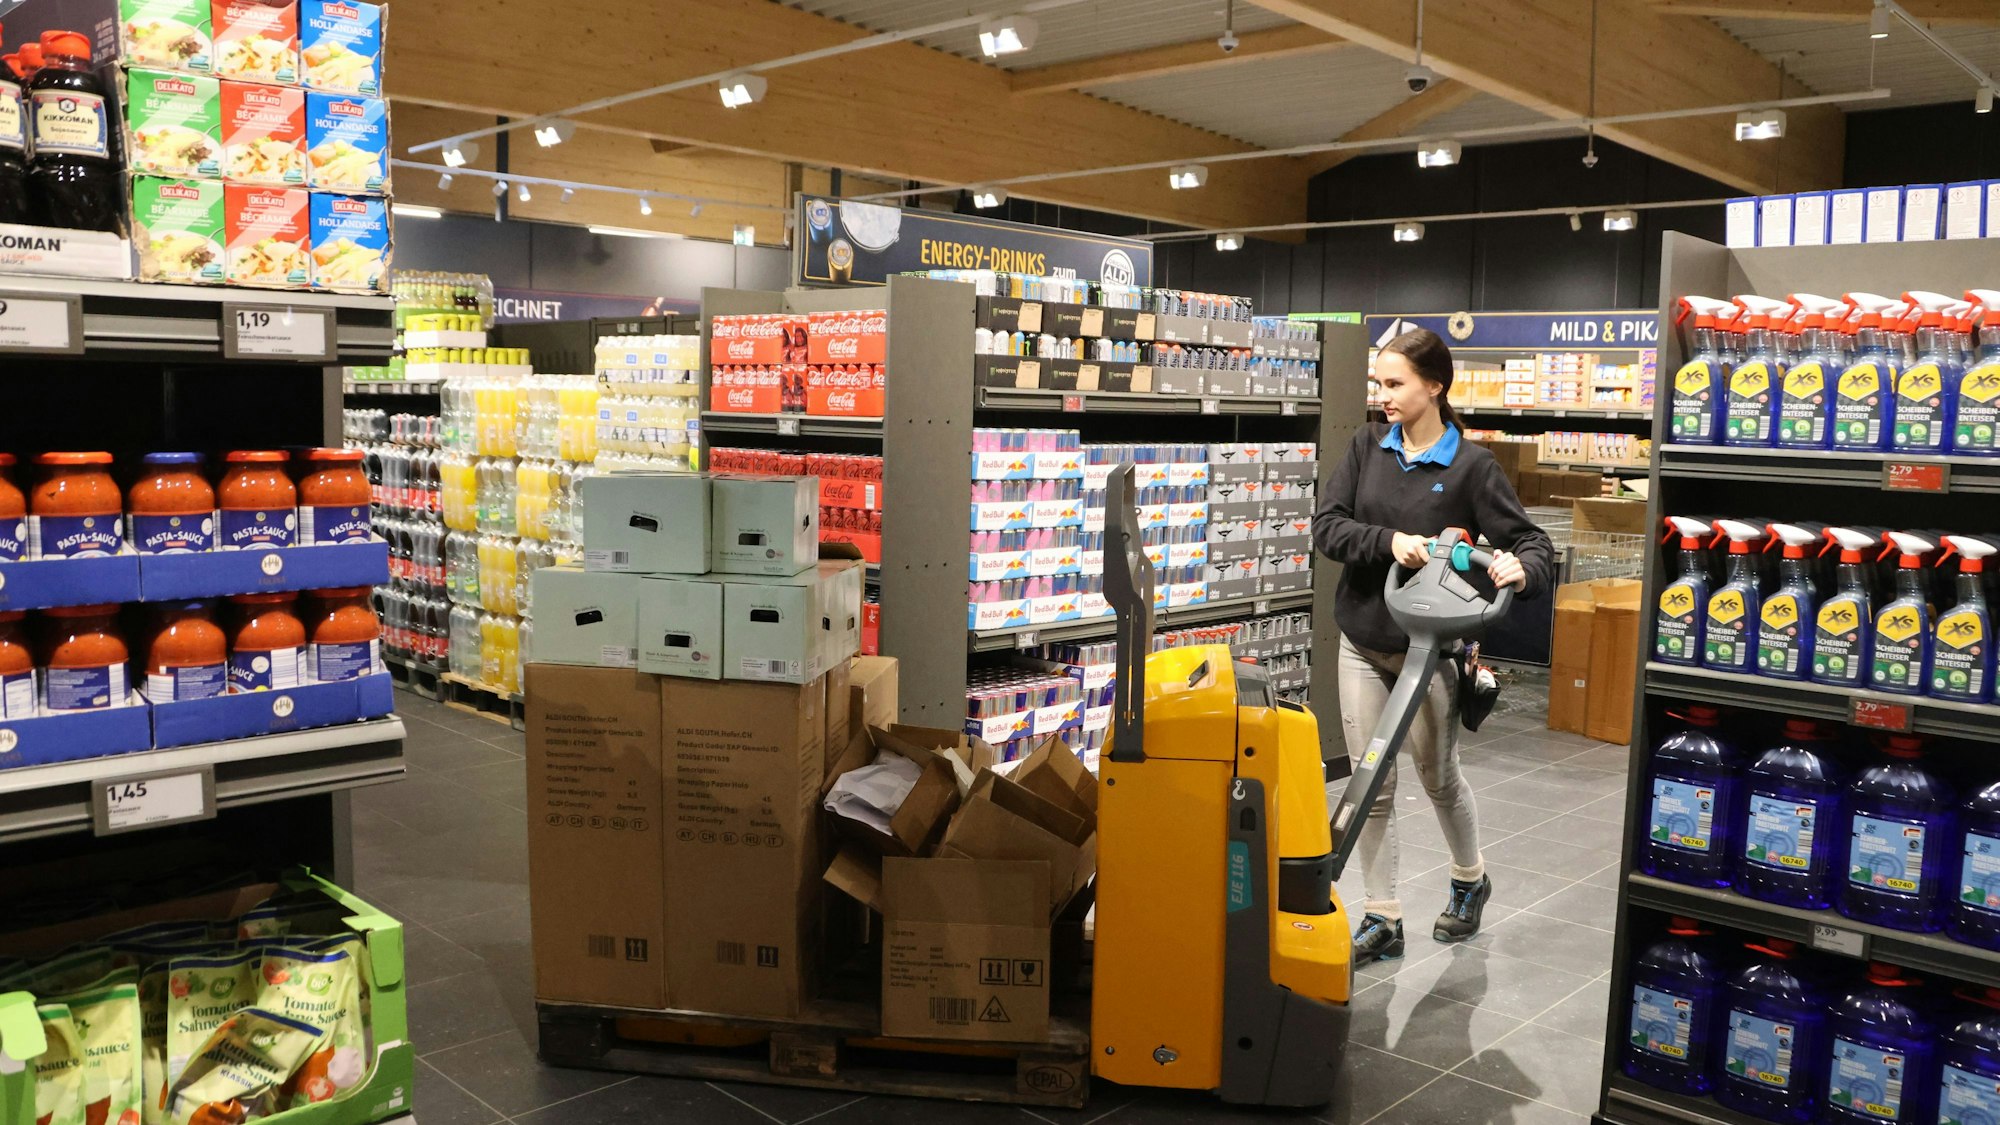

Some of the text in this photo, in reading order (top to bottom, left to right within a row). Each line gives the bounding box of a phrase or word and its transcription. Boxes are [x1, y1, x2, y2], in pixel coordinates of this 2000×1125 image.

[226, 6, 280, 23] BÉCHAMEL
[325, 5, 358, 18] DELIKATO
[310, 18, 373, 37] HOLLANDAISE
[157, 81, 194, 95] DELIKATO
[247, 94, 280, 106] DELIKATO
[331, 103, 363, 116] DELIKATO
[44, 114, 93, 124] KIKKOMAN
[236, 110, 290, 125] BÉCHAMEL
[315, 118, 378, 135] HOLLANDAISE
[162, 186, 198, 199] DELIKATO
[250, 194, 284, 208] DELIKATO
[334, 200, 366, 214] DELIKATO
[240, 210, 294, 226] BÉCHAMEL
[319, 217, 381, 231] HOLLANDAISE
[0, 235, 60, 252] OMAN
[922, 239, 1077, 280] ENERGY-DRINKS zum
[1104, 266, 1133, 286] ALDI
[237, 312, 270, 330] 1,19
[1550, 321, 1598, 342] MILD
[1602, 320, 1616, 343] &
[1681, 370, 1704, 384] XS
[1738, 372, 1763, 387] XS
[1793, 372, 1818, 387] XS
[1846, 374, 1872, 388] XS
[1907, 374, 1934, 390] XS
[1890, 466, 1912, 475] 2,79
[57, 532, 117, 550] PASTA-SAUCE
[146, 531, 204, 548] PASTA-SAUCE
[233, 526, 288, 542] PASTA-SAUCE
[1666, 594, 1688, 607] XS
[1715, 599, 1738, 612] XS
[1768, 604, 1791, 618] XS
[1825, 610, 1852, 624] XS
[1659, 620, 1689, 629] SCHEIBEN-
[1886, 616, 1914, 630] XS
[1946, 622, 1975, 636] XS
[1658, 627, 1685, 635] ENTEISER
[1707, 626, 1739, 635] SCHEIBEN-
[1760, 632, 1792, 641] SCHEIBEN-
[1707, 634, 1735, 642] ENTEISER
[1759, 639, 1788, 648] ENTEISER
[1816, 639, 1852, 648] SCHEIBEN-
[1815, 646, 1847, 654] ENTEISER
[1876, 645, 1914, 654] SCHEIBEN-
[1876, 652, 1909, 661] ENTEISER
[1936, 652, 1975, 661] SCHEIBEN-
[1935, 660, 1971, 668] ENTEISER
[1856, 702, 1877, 712] 2,79
[107, 782, 147, 804] 1,45
[1782, 857, 1803, 866] 16740
[1231, 854, 1244, 904] EJE 116
[1889, 879, 1912, 888] 16740
[310, 977, 328, 988] bio
[179, 1018, 218, 1033] Sahne
[253, 1033, 270, 1045] bio
[219, 1038, 279, 1074] Tomaten
[1662, 1045, 1681, 1055] 16740
[220, 1068, 255, 1089] KLASSIK
[1762, 1073, 1782, 1083] 16740
[1868, 1105, 1891, 1115] 16740
